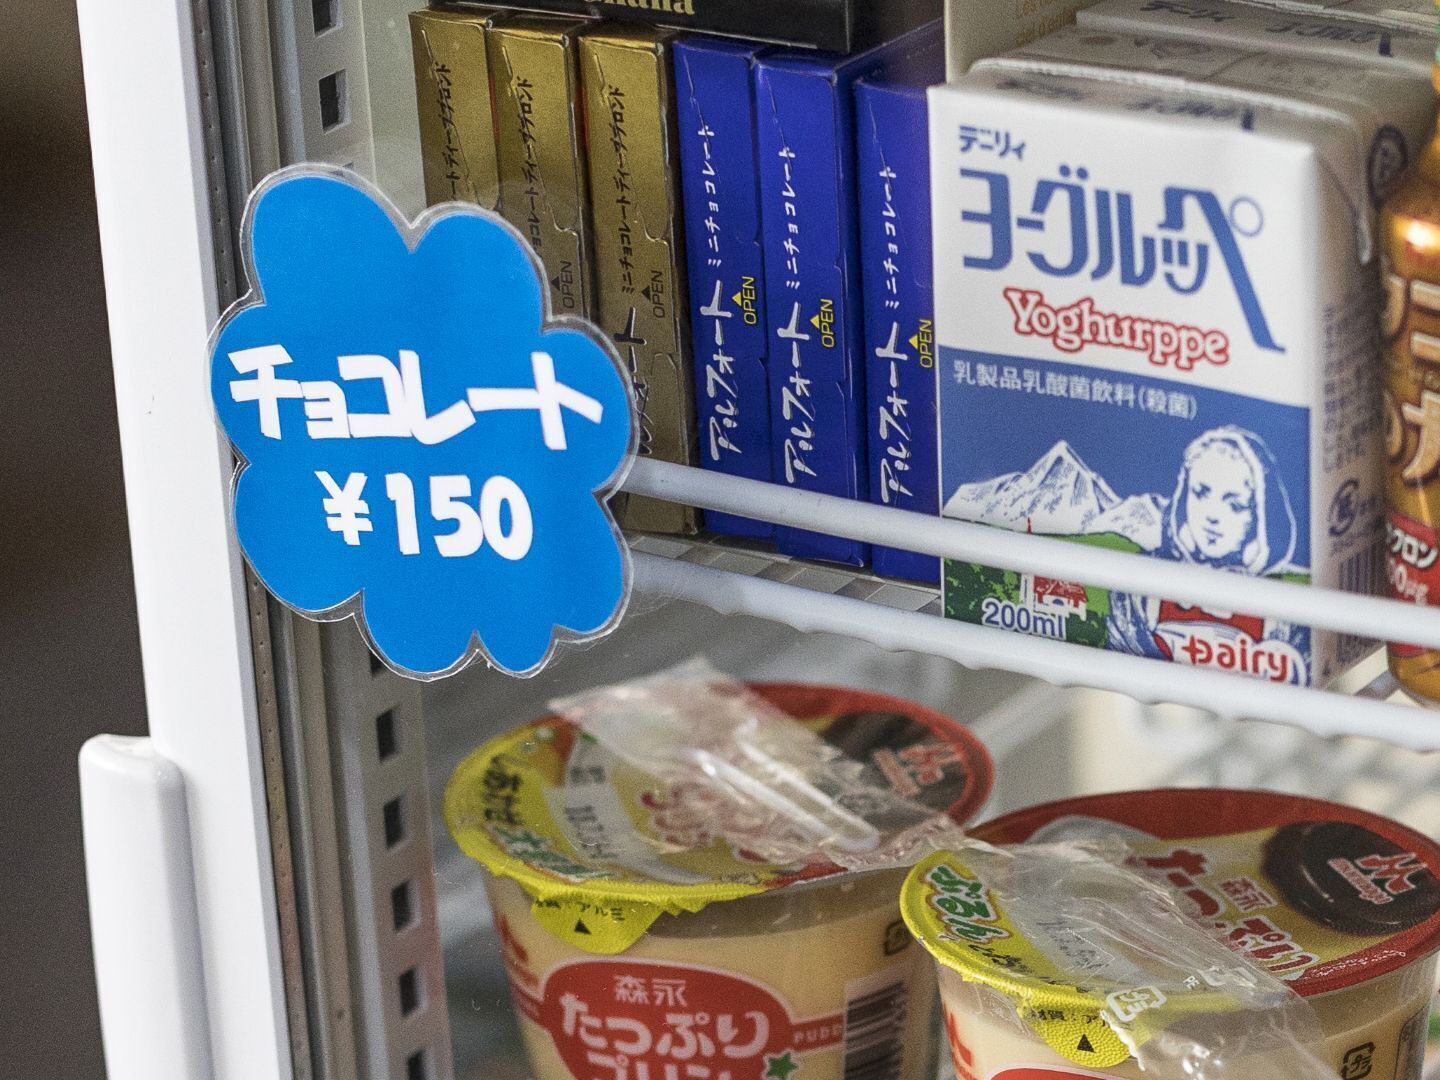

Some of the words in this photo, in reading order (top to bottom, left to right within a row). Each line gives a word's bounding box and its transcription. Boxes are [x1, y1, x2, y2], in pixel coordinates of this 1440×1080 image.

[697, 125, 723, 268] ミニチョコレート
[778, 146, 801, 290] ミニチョコレート
[879, 165, 901, 310] ミニチョコレート
[560, 261, 575, 309] OPEN
[652, 270, 665, 319] OPEN
[744, 276, 756, 325] OPEN
[958, 163, 1287, 354] ヨーグルッペ
[821, 299, 834, 348] OPEN
[920, 319, 933, 369] OPEN
[1003, 286, 1232, 371] Yoghurppe
[227, 344, 604, 450] チョコレート
[700, 280, 742, 461] アルフォート
[776, 302, 817, 484] アルフォート
[875, 322, 913, 504] アルフォート
[314, 470, 534, 561] ¥150
[982, 597, 1068, 641] 200ml
[559, 993, 770, 1060] たっぷり
[614, 975, 687, 1007] 森永
